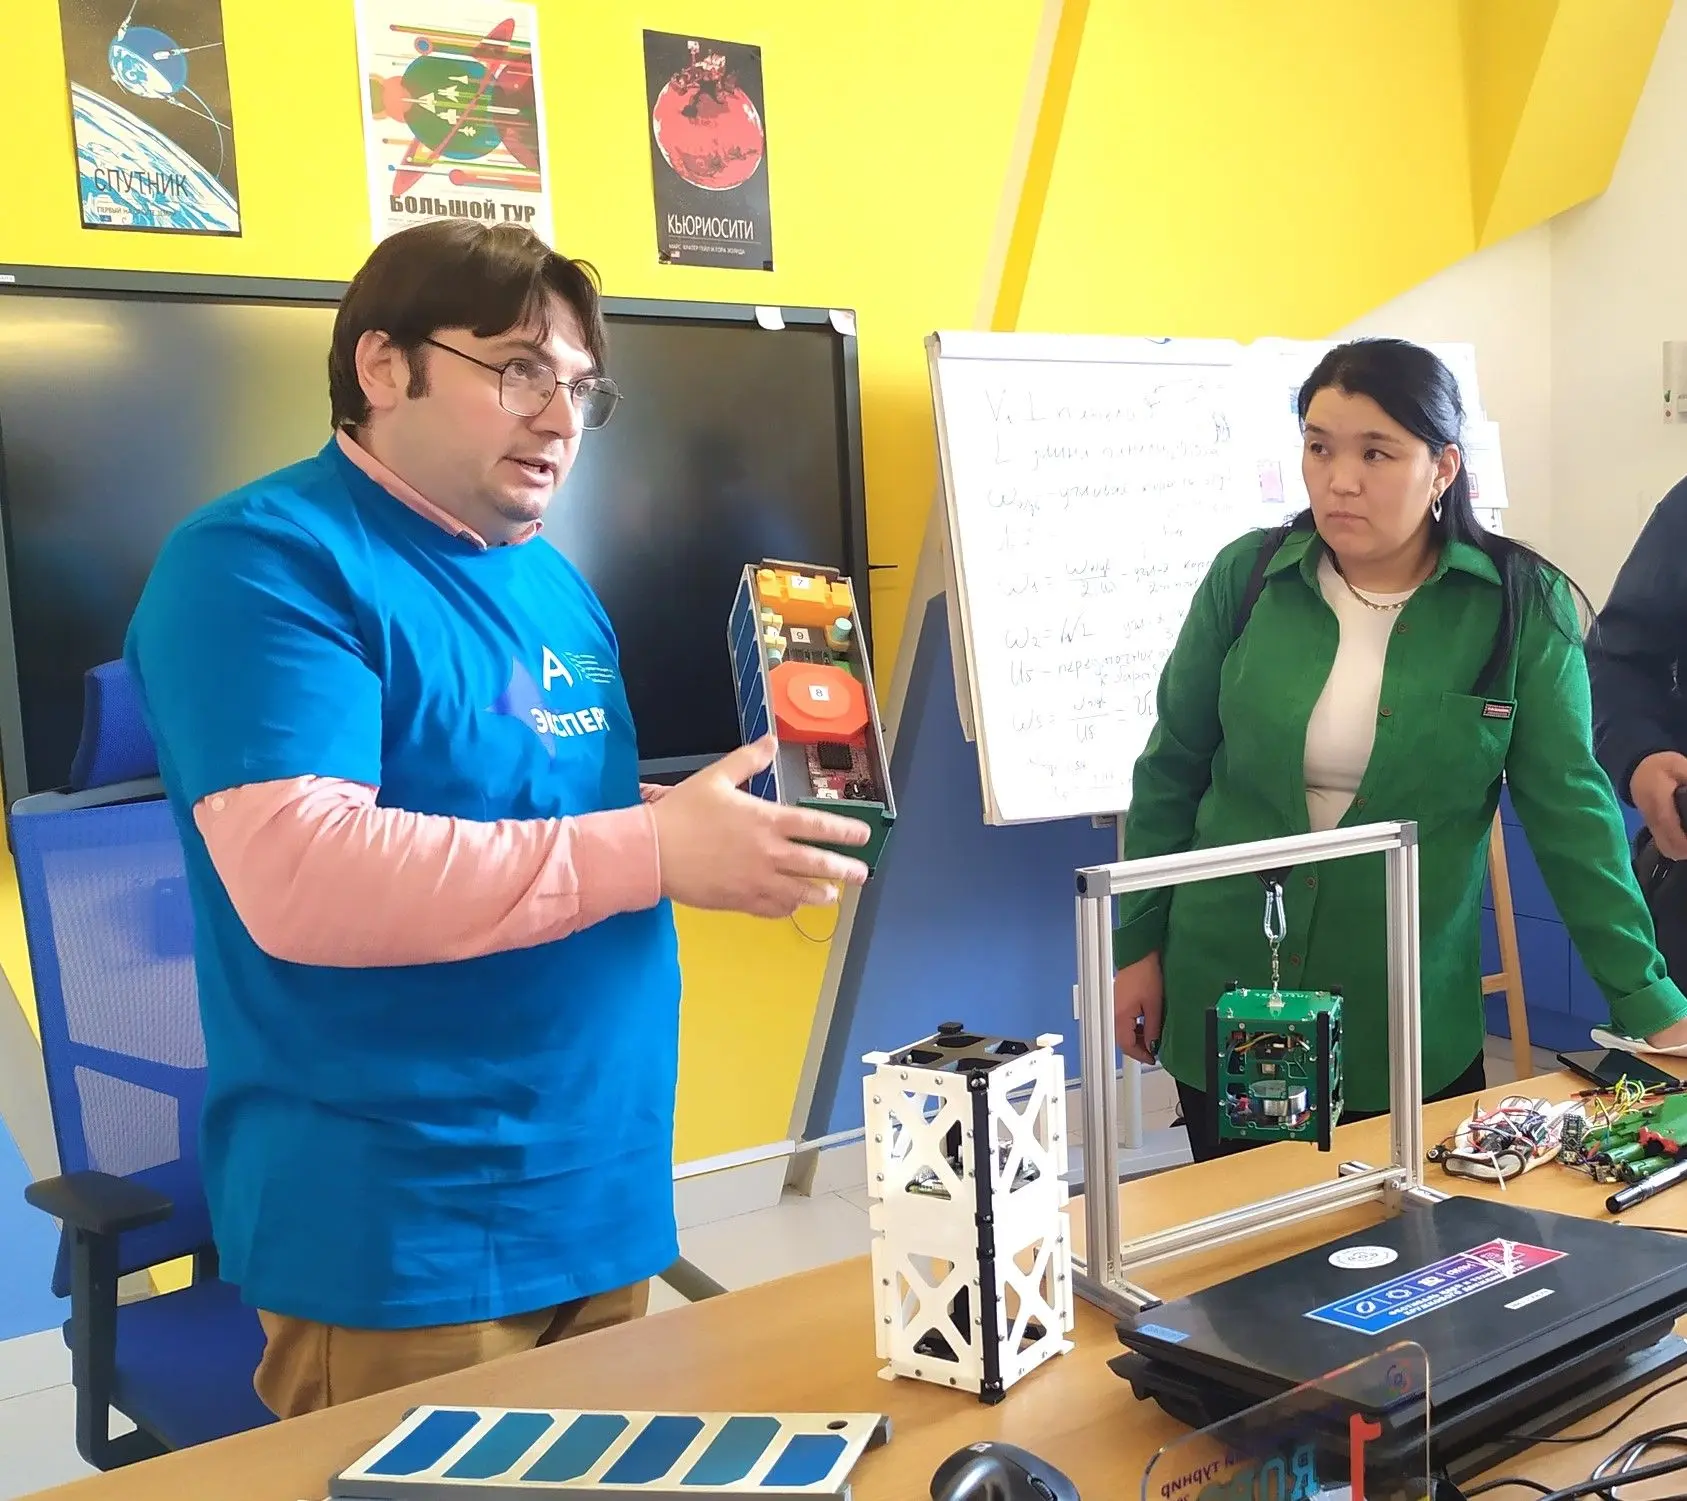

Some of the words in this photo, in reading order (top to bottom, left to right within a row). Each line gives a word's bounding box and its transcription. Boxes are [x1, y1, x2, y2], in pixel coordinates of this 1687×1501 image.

[94, 167, 190, 198] СПУТНИК
[389, 195, 497, 221] БОЛЬШОЙ
[500, 203, 537, 223] ТУР
[667, 213, 755, 241] КЬЮРИОСИТИ
[796, 631, 804, 641] 9
[815, 688, 823, 697] 8
